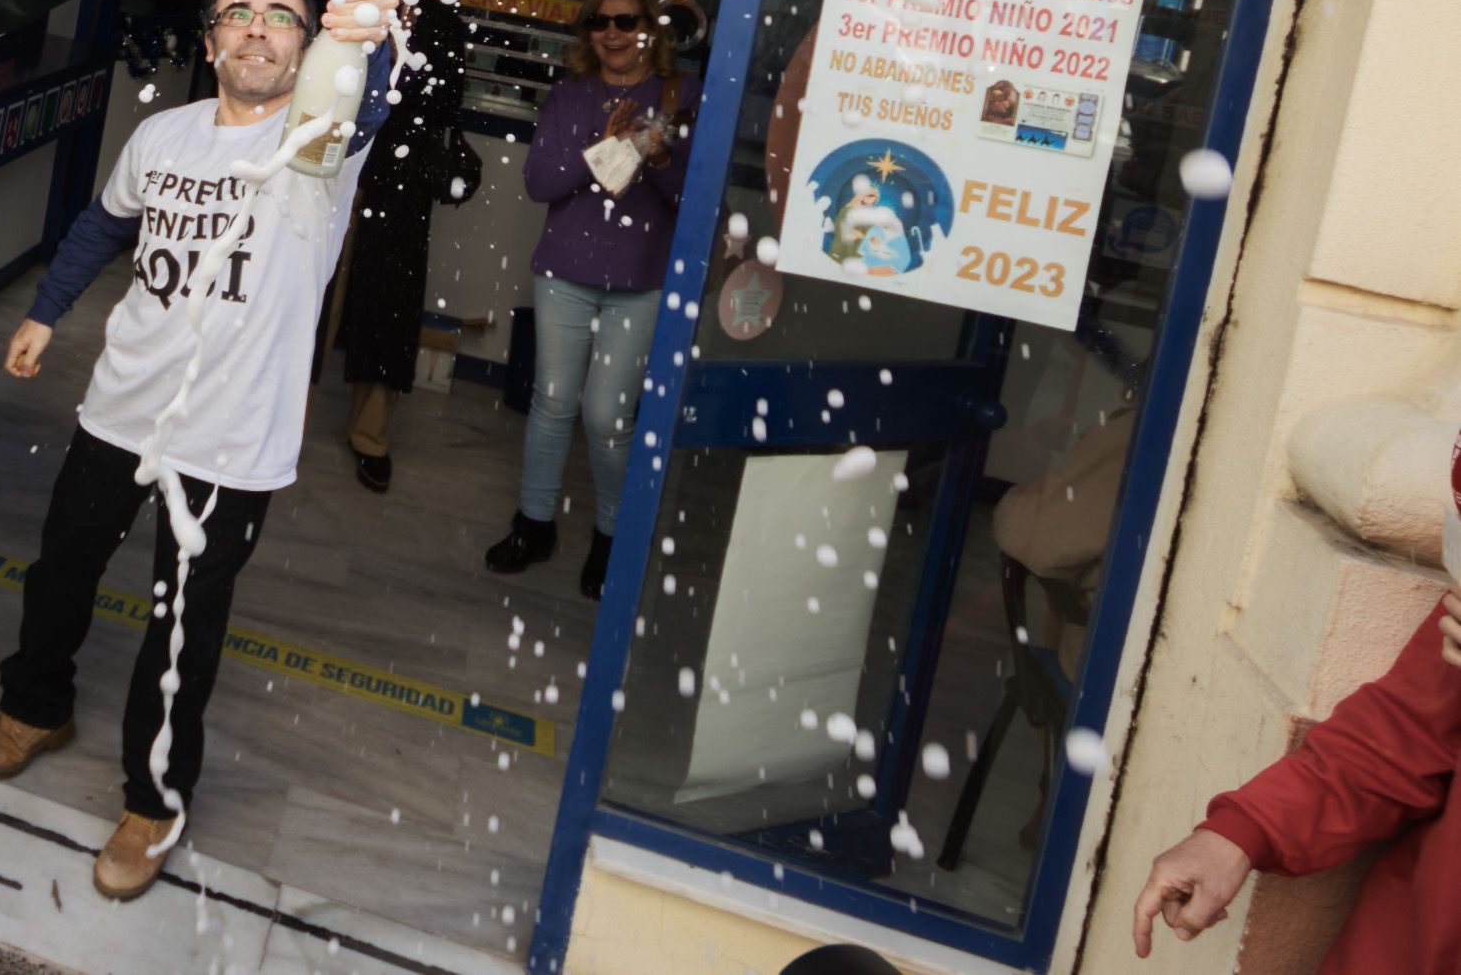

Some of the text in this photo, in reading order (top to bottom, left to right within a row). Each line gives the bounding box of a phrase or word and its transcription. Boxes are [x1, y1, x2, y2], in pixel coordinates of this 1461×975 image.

[838, 13, 1111, 82] 3er PREMIO NIÑO 2022
[989, 0, 1052, 34] NIÑO
[1060, 12, 1118, 44] 2021
[829, 48, 975, 96] NO ABANDONES
[837, 91, 954, 132] TUS SUEÑOS
[958, 180, 1092, 237] FELIZ
[956, 245, 1067, 299] 2023
[284, 652, 315, 678] DE
[319, 661, 457, 716] SEGURIDAD
